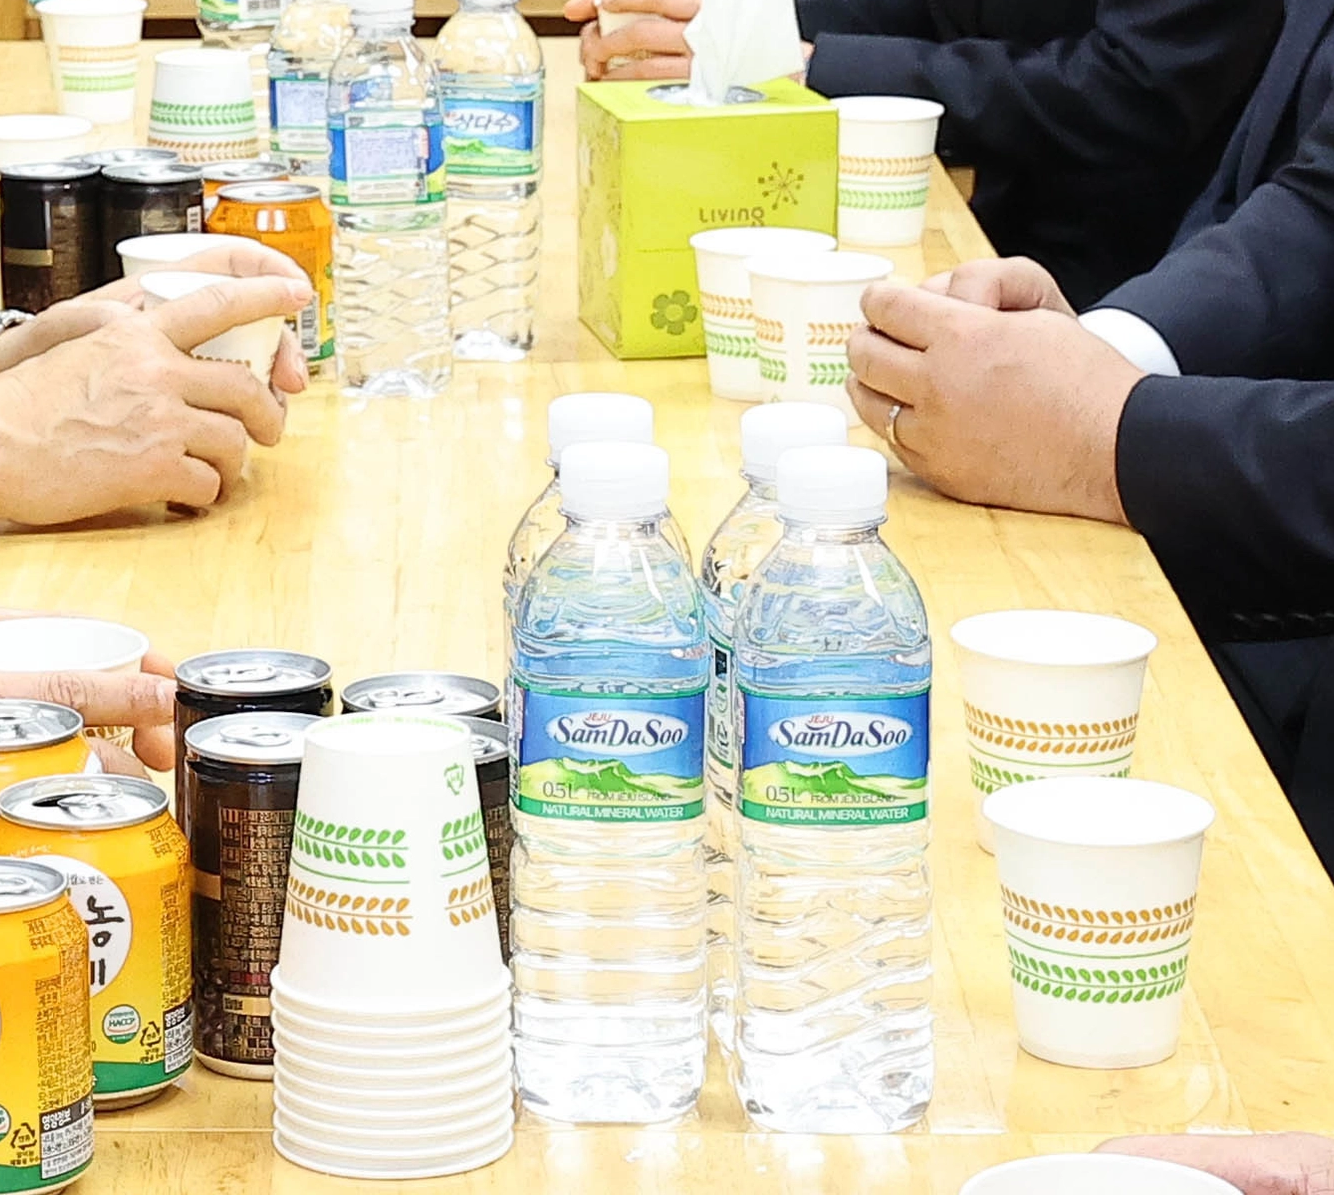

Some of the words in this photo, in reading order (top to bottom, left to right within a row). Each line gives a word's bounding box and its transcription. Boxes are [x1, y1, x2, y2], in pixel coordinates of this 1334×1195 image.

[586, 711, 612, 722] JEJU
[807, 714, 833, 725] JEJU
[553, 716, 683, 747] SamDaSoo
[775, 719, 907, 749] SamDaSoo
[542, 804, 594, 817] NATURAL
[594, 806, 644, 818] MINERAL
[645, 806, 684, 818] WATER
[765, 808, 818, 820] NATURAL
[819, 809, 869, 821] MINERAL
[869, 808, 909, 820] WATER
[108, 1018, 135, 1027] HACCP
[42, 1108, 72, 1131] 영양정보
